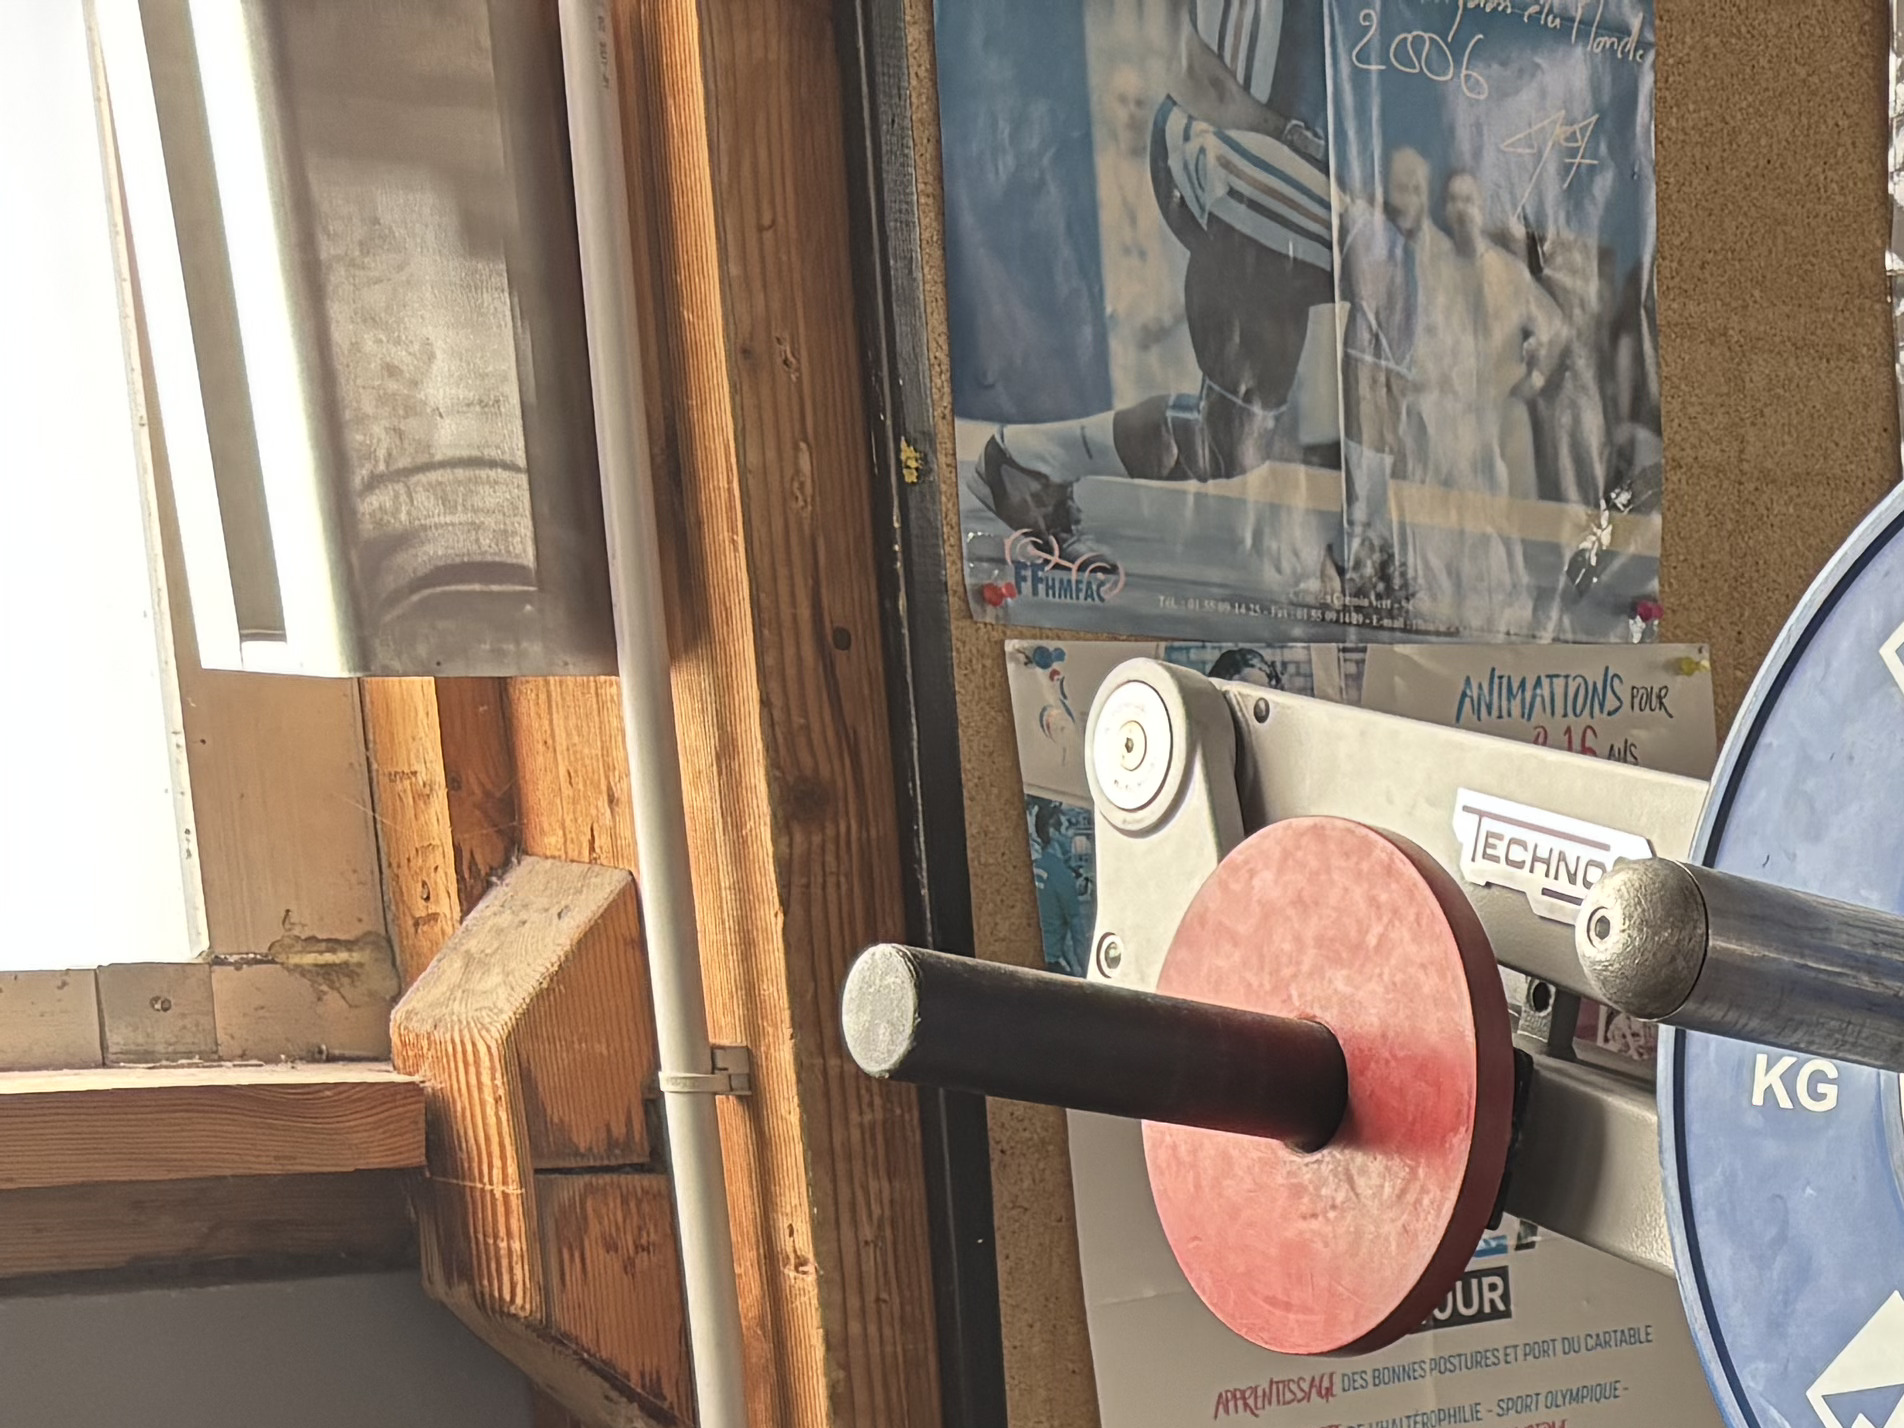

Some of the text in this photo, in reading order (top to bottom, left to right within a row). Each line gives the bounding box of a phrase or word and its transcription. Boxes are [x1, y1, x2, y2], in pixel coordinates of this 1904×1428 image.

[1351, 9, 1489, 100] 2006
[1455, 666, 1674, 724] ANIMATIONS POUR
[1750, 1053, 1840, 1114] KG
[1213, 1324, 1654, 1419] APPRENTISSAGE DES BONNES POSTURES ET PORT DU CARTABLE
[1496, 1391, 1541, 1417] SPORT
[1543, 1380, 1622, 1410] OLYMPIQUE
